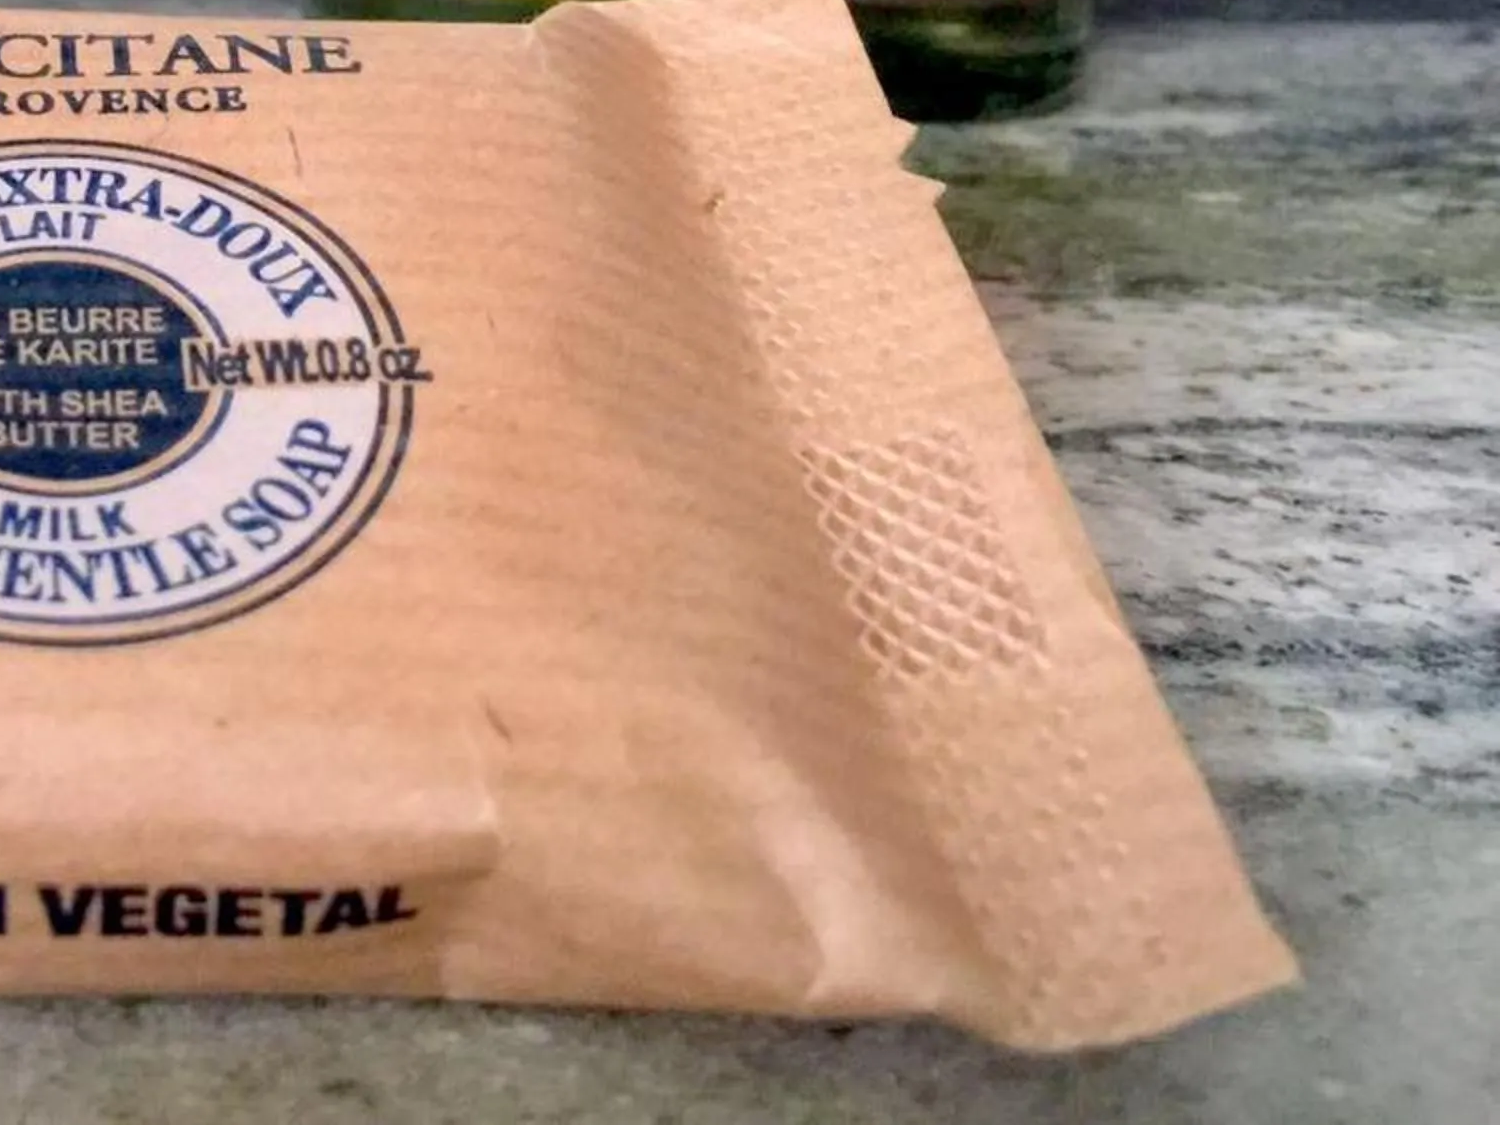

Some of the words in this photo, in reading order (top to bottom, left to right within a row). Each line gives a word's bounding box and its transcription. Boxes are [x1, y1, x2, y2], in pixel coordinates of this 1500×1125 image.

[0, 211, 107, 243] LAIT
[8, 306, 165, 334] BEURRE
[17, 339, 159, 365] KARITE
[186, 341, 253, 386] Net
[377, 347, 434, 383] oz.
[60, 390, 169, 416] SHEA
[222, 419, 354, 552] SOAP
[0, 499, 135, 543] MILK
[36, 885, 420, 937] VEGETAL
